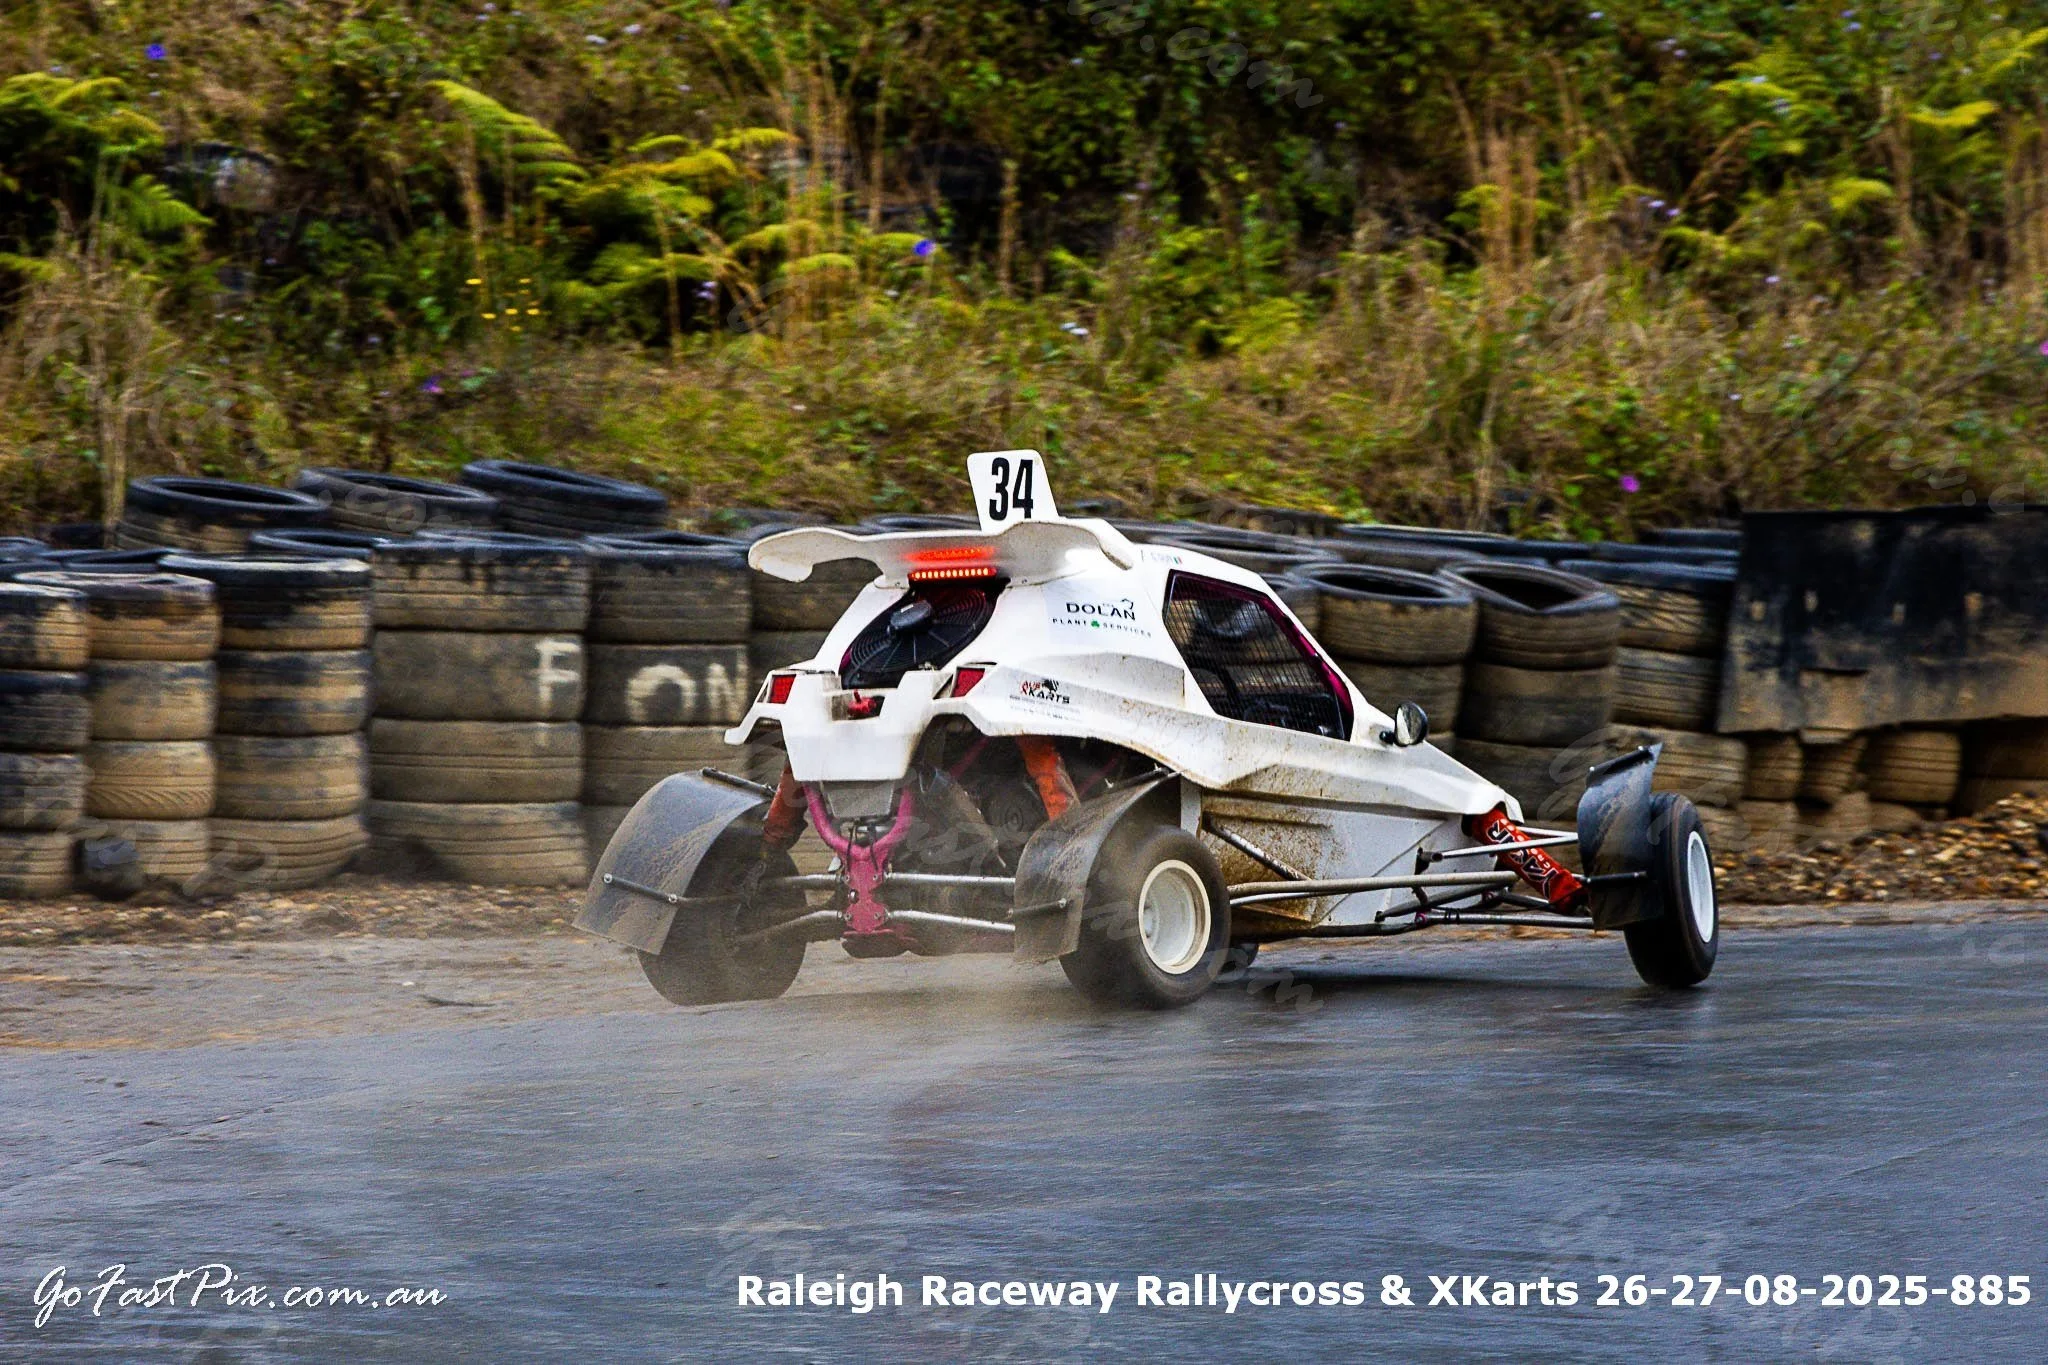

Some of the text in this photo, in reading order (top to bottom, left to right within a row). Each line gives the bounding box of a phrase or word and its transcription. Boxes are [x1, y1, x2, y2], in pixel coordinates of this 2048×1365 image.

[989, 457, 1034, 521] 34
[1066, 602, 1136, 621] DOLAN
[1053, 618, 1087, 626] PLANT
